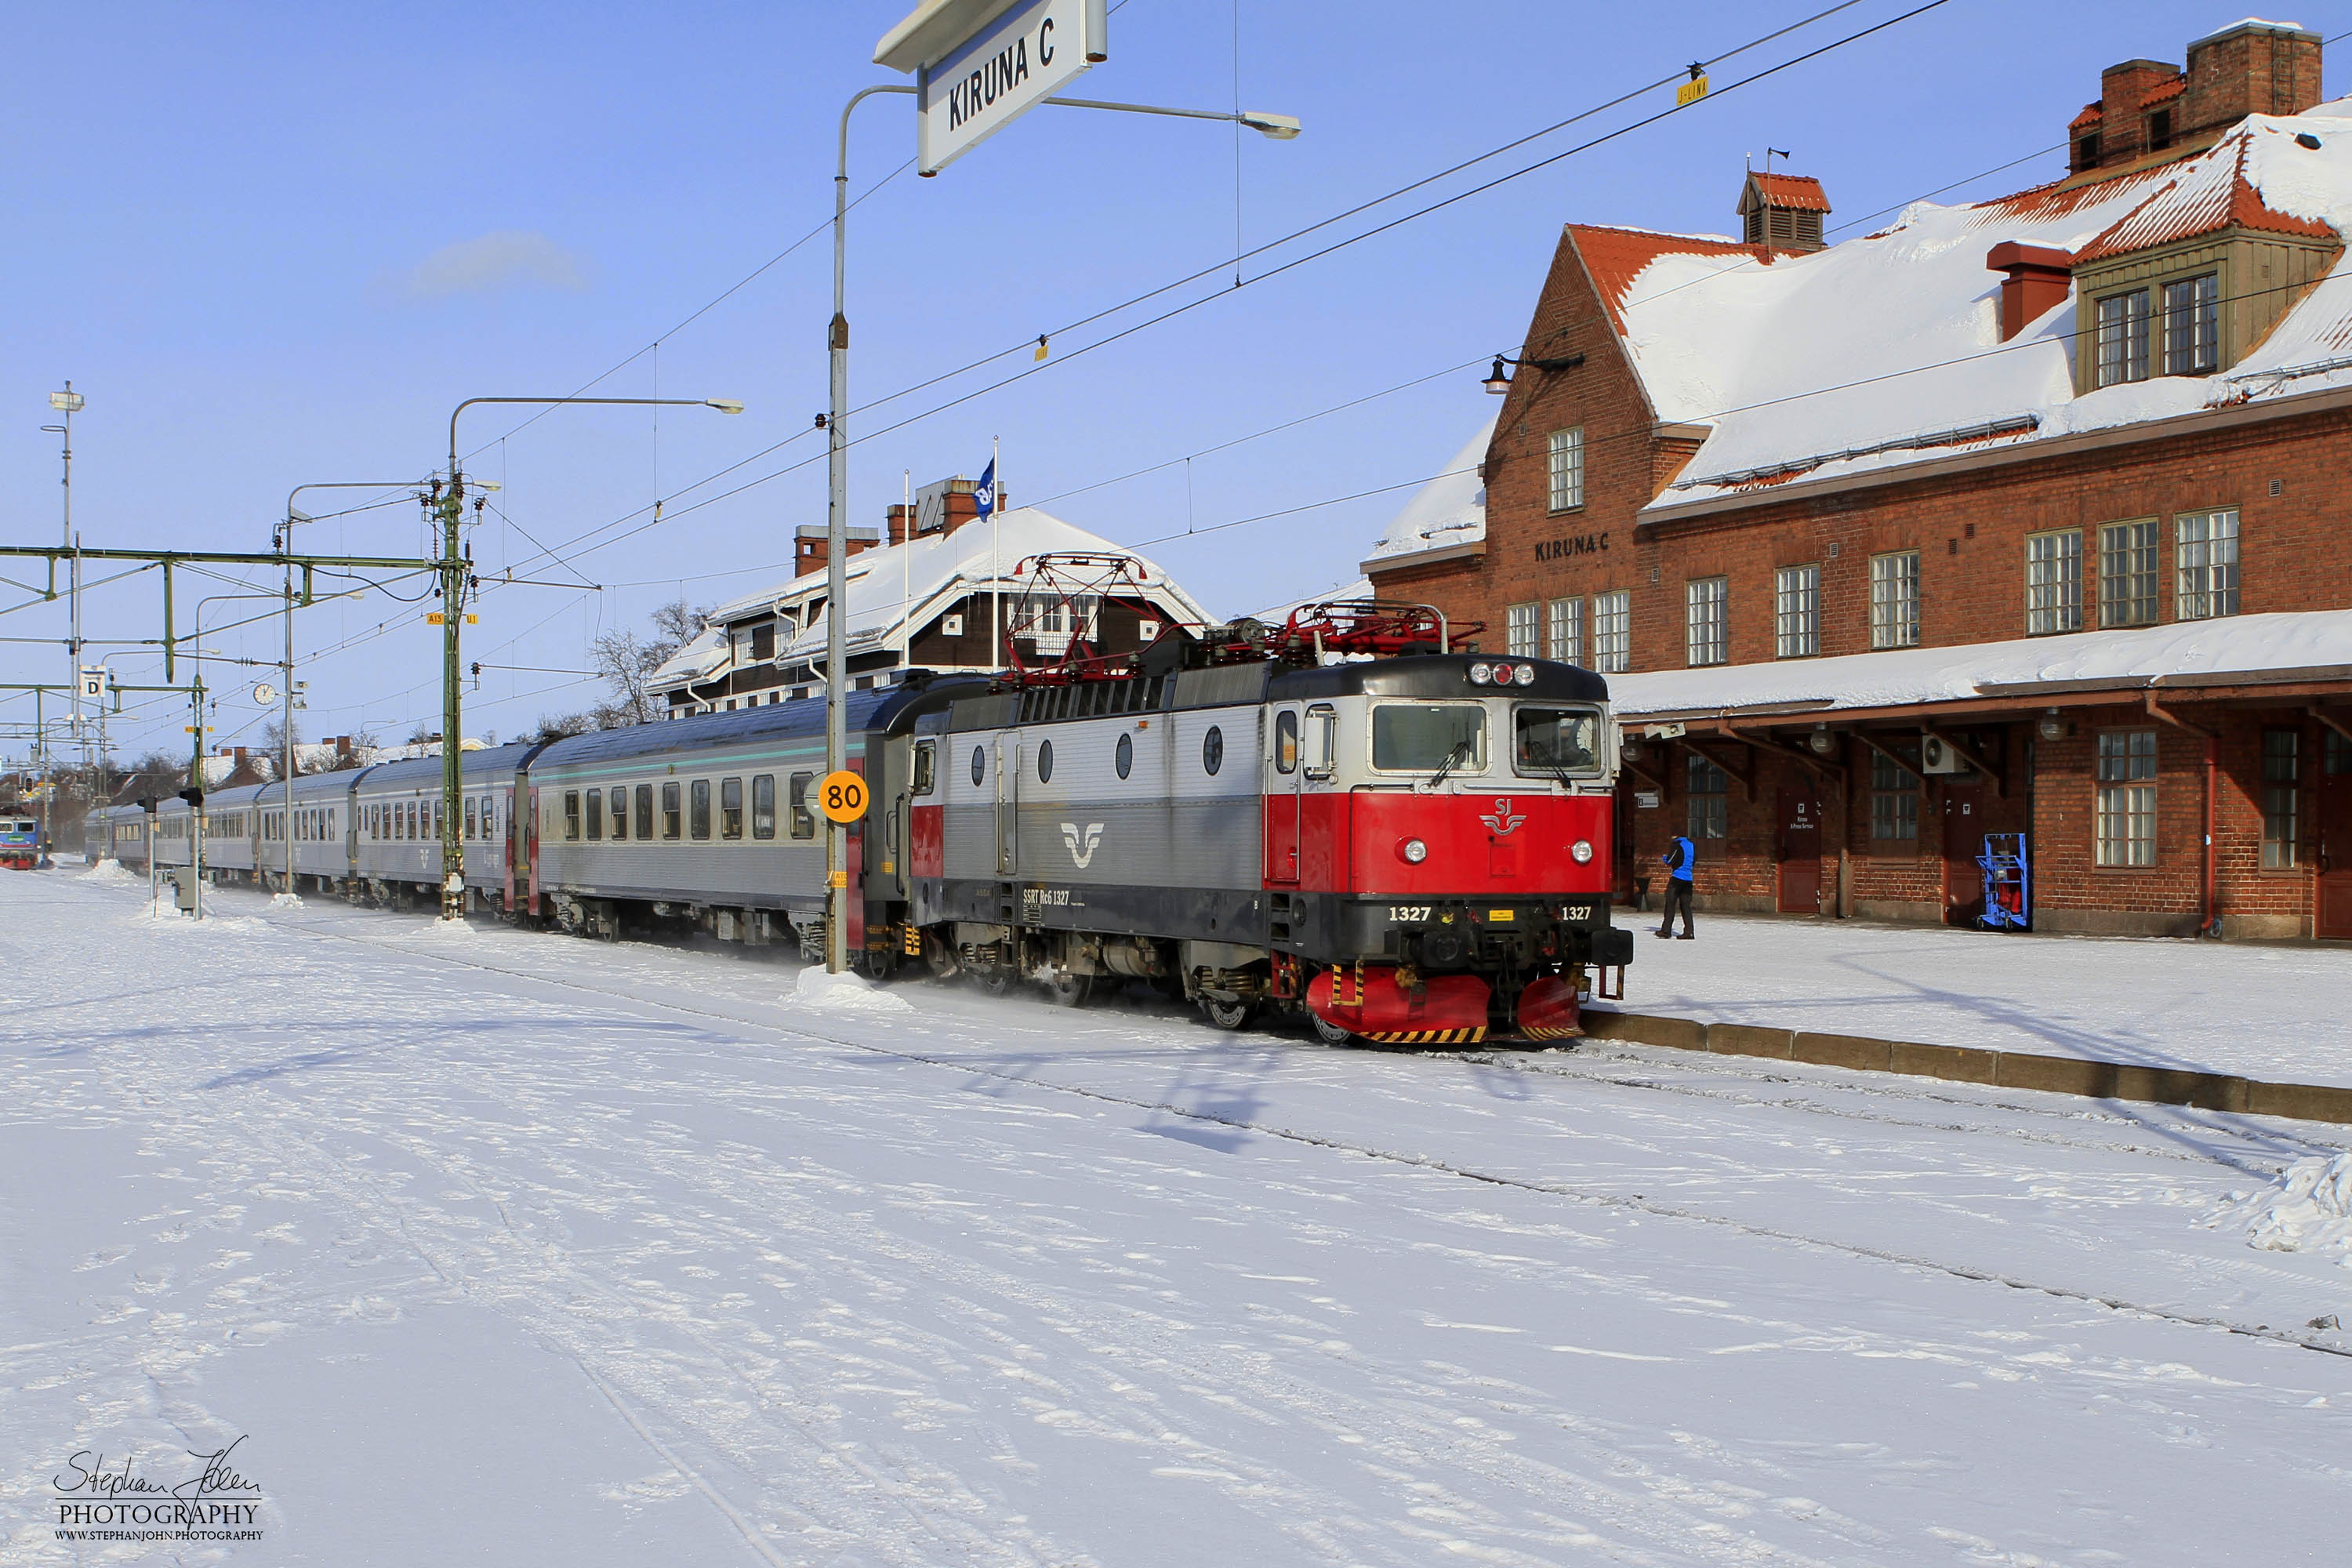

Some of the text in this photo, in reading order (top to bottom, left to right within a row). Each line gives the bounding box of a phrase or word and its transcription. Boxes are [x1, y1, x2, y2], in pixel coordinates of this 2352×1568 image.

[949, 17, 1054, 132] KIRUNA C
[1534, 532, 1609, 562] KIRUNA C
[88, 681, 99, 695] D
[828, 784, 862, 809] 80
[1495, 798, 1512, 816] SJ
[1023, 888, 1069, 906] SSRT Rc6 1327
[1389, 906, 1432, 921] 1327
[1563, 906, 1592, 920] 1327
